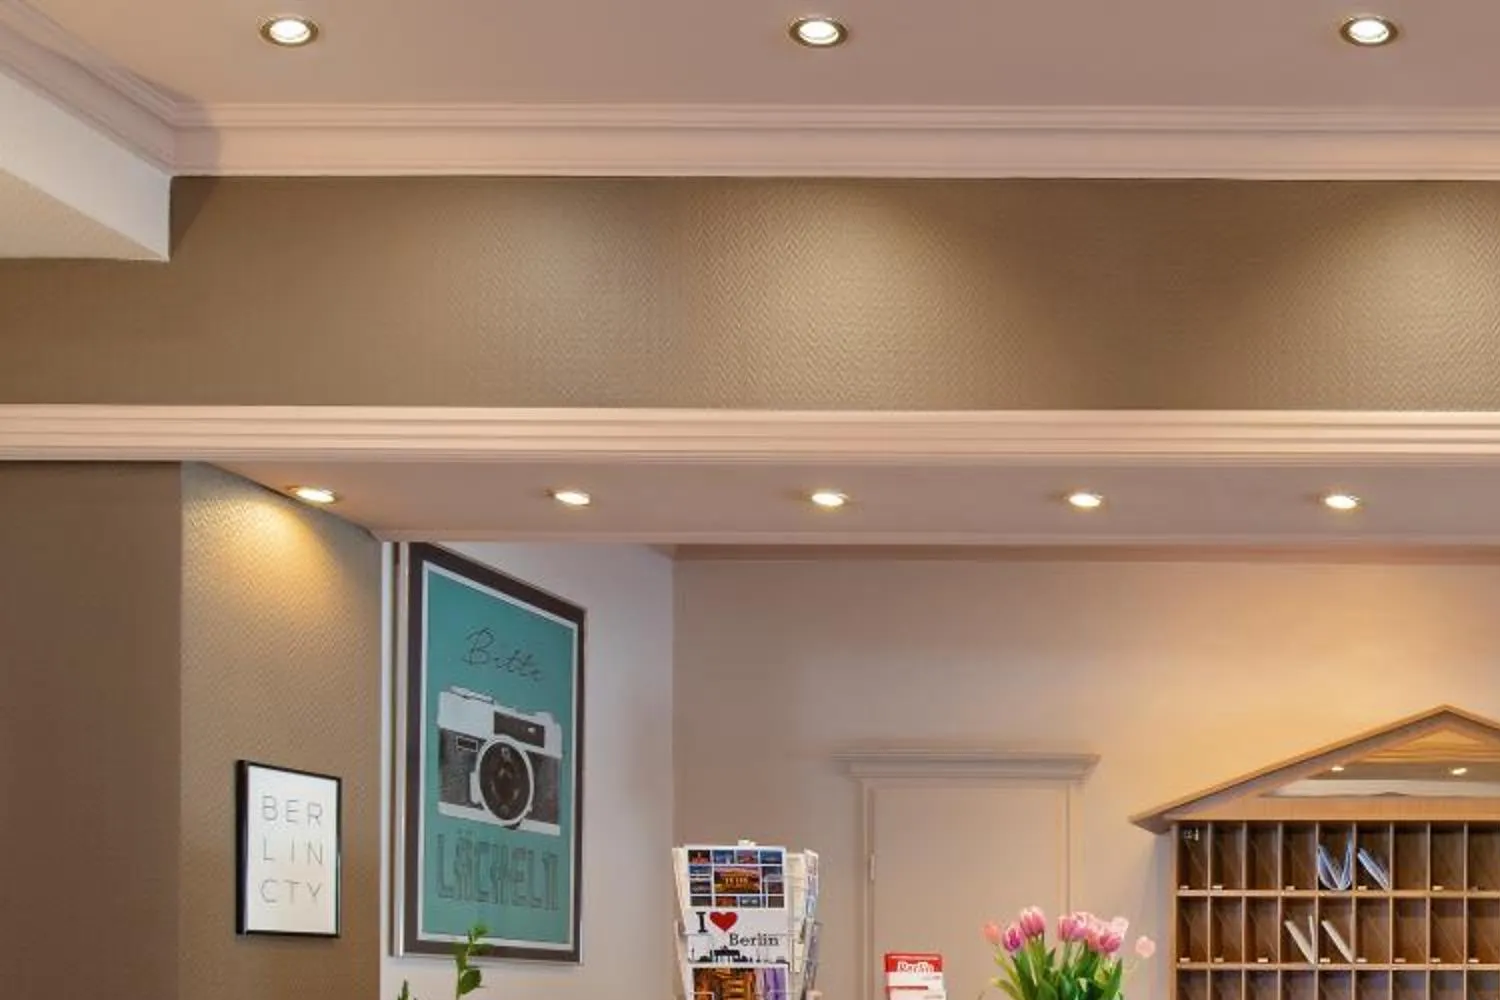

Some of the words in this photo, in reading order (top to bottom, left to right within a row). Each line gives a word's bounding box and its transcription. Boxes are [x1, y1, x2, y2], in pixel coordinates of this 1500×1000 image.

[262, 795, 323, 826] BER
[262, 836, 323, 866] LIN
[260, 879, 322, 905] CTY
[696, 911, 708, 933] I
[729, 932, 779, 947] Berlin
